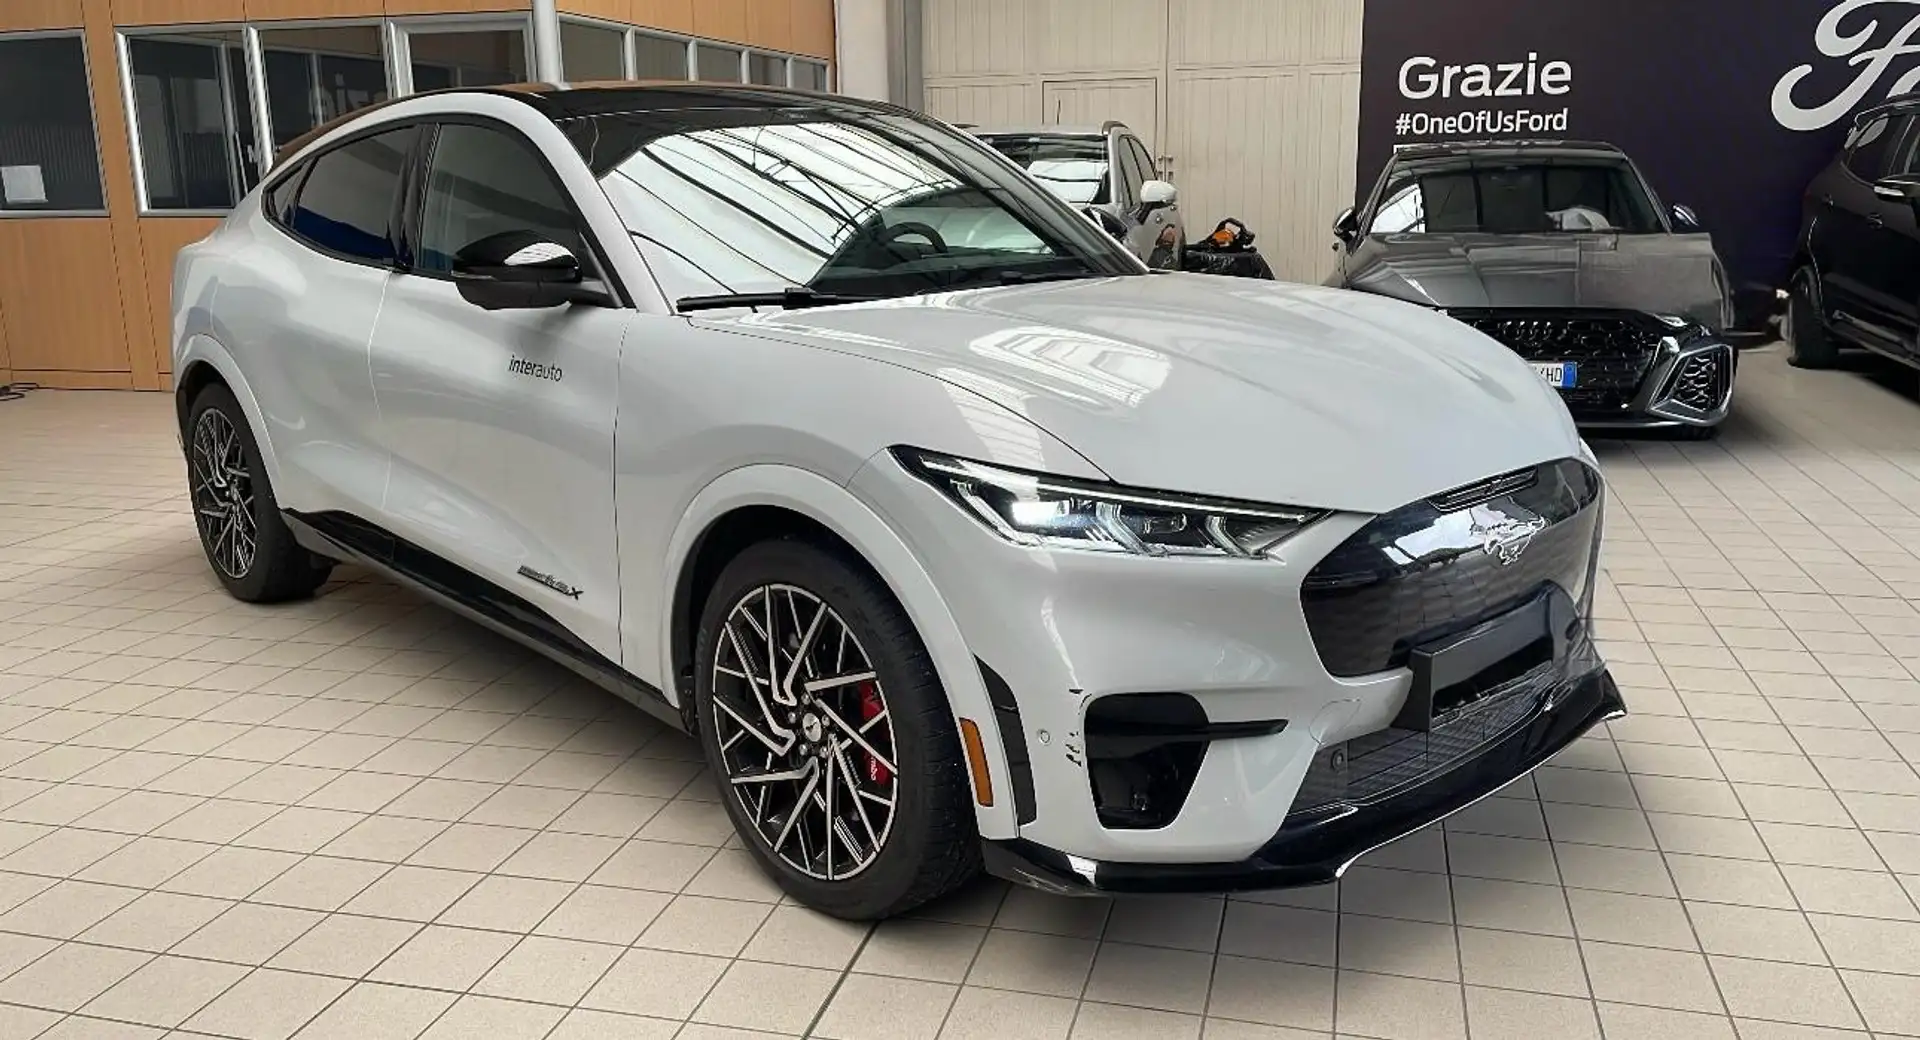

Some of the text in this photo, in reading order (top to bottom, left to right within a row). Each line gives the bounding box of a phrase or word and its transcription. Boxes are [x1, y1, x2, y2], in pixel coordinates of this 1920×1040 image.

[1398, 51, 1572, 100] Grazie
[1770, 0, 1920, 131] F
[1395, 107, 1569, 136] #OneOfUsFord
[508, 354, 563, 382] interauto
